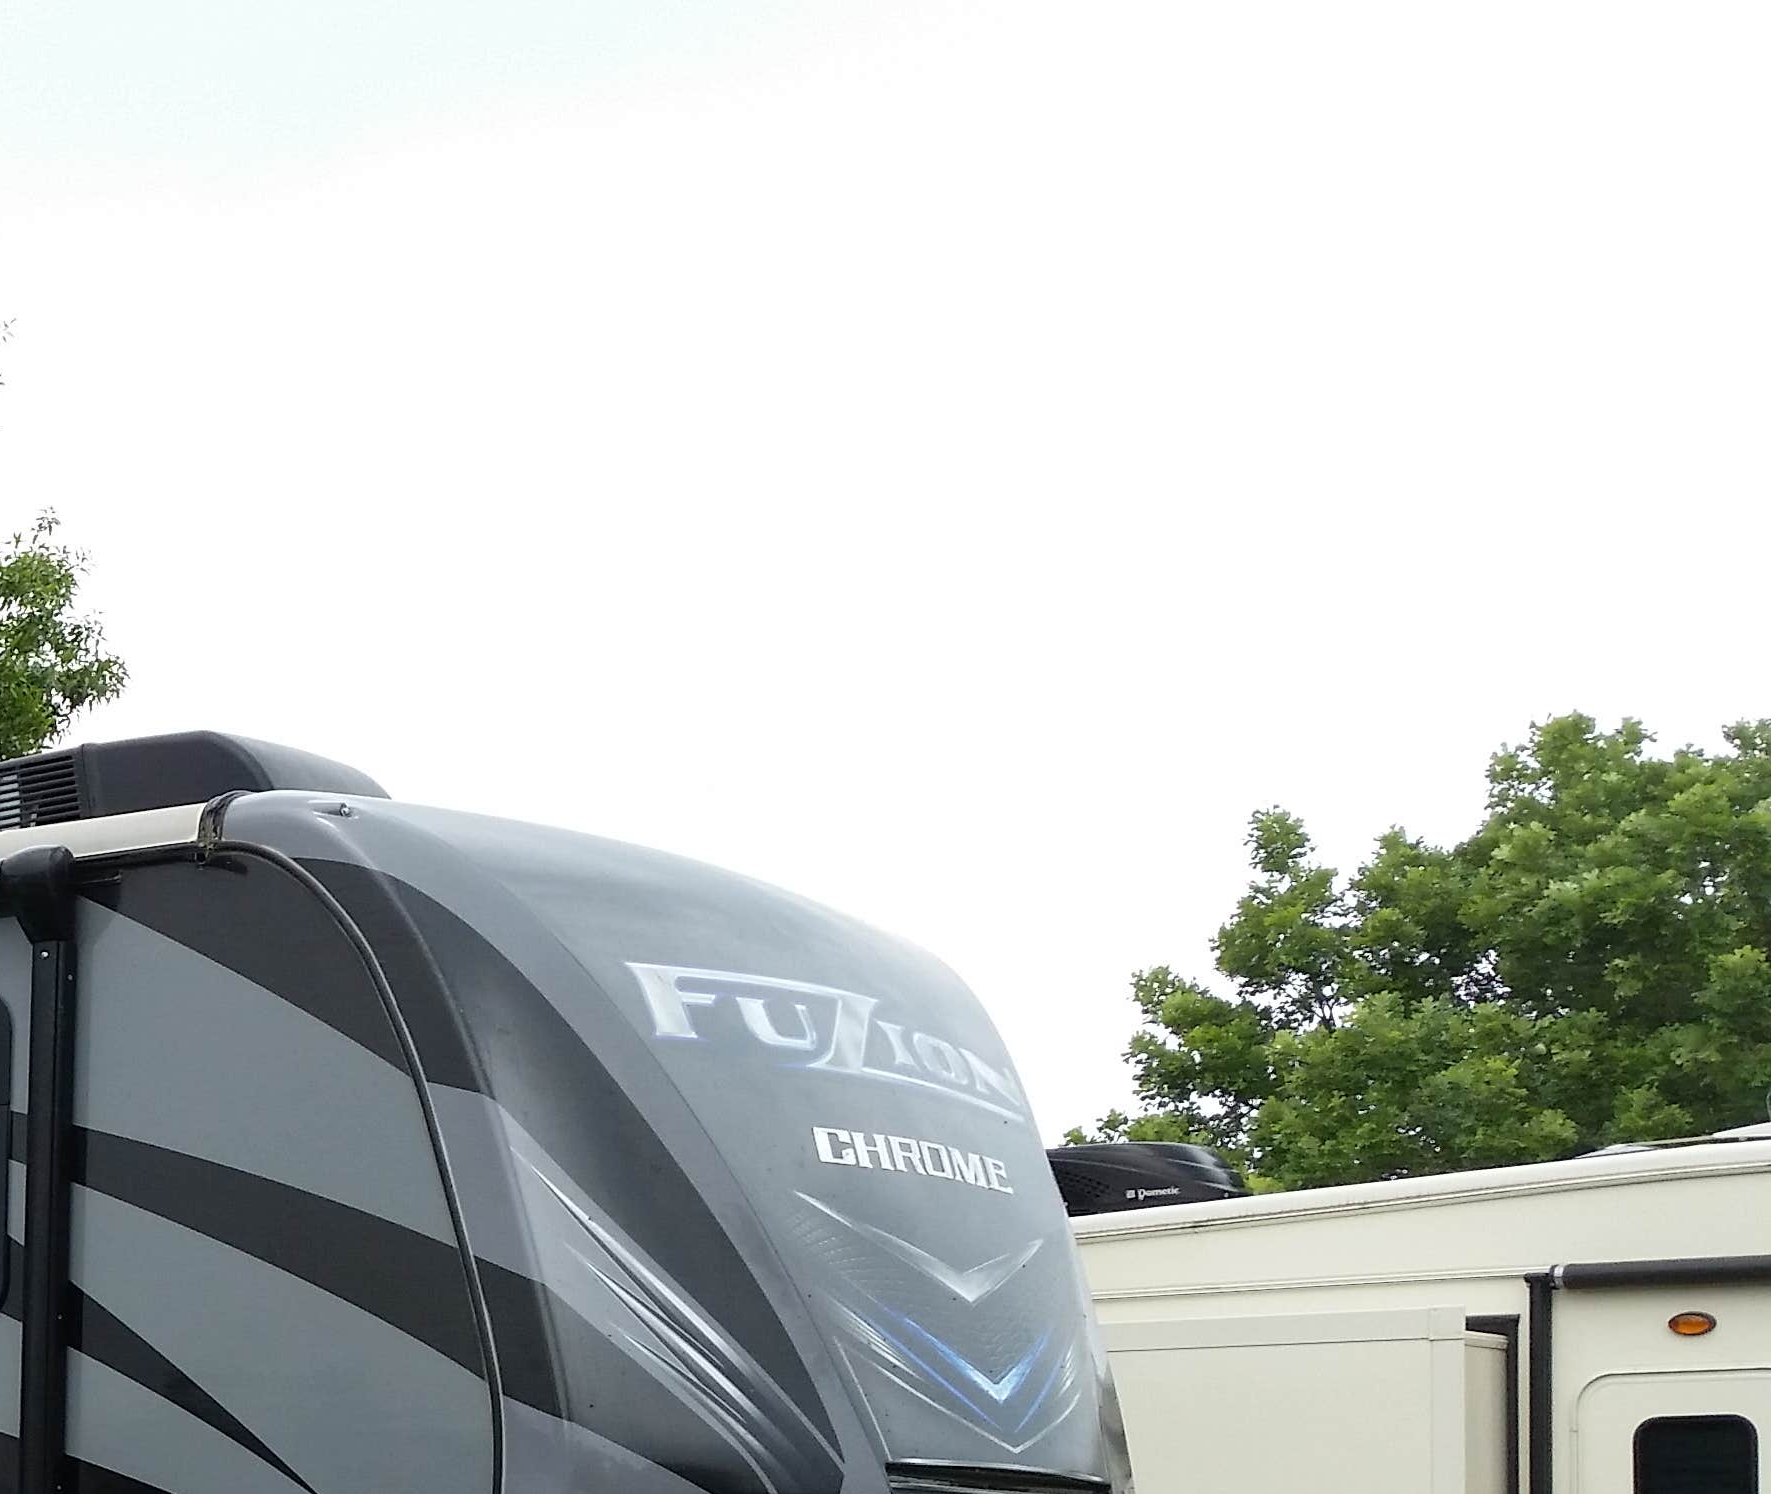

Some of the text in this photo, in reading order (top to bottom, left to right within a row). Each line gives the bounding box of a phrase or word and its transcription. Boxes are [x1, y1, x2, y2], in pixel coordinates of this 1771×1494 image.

[625, 961, 1025, 1123] FUZION
[812, 1126, 1013, 1195] CHROME
[1138, 1186, 1180, 1201] Dometic
